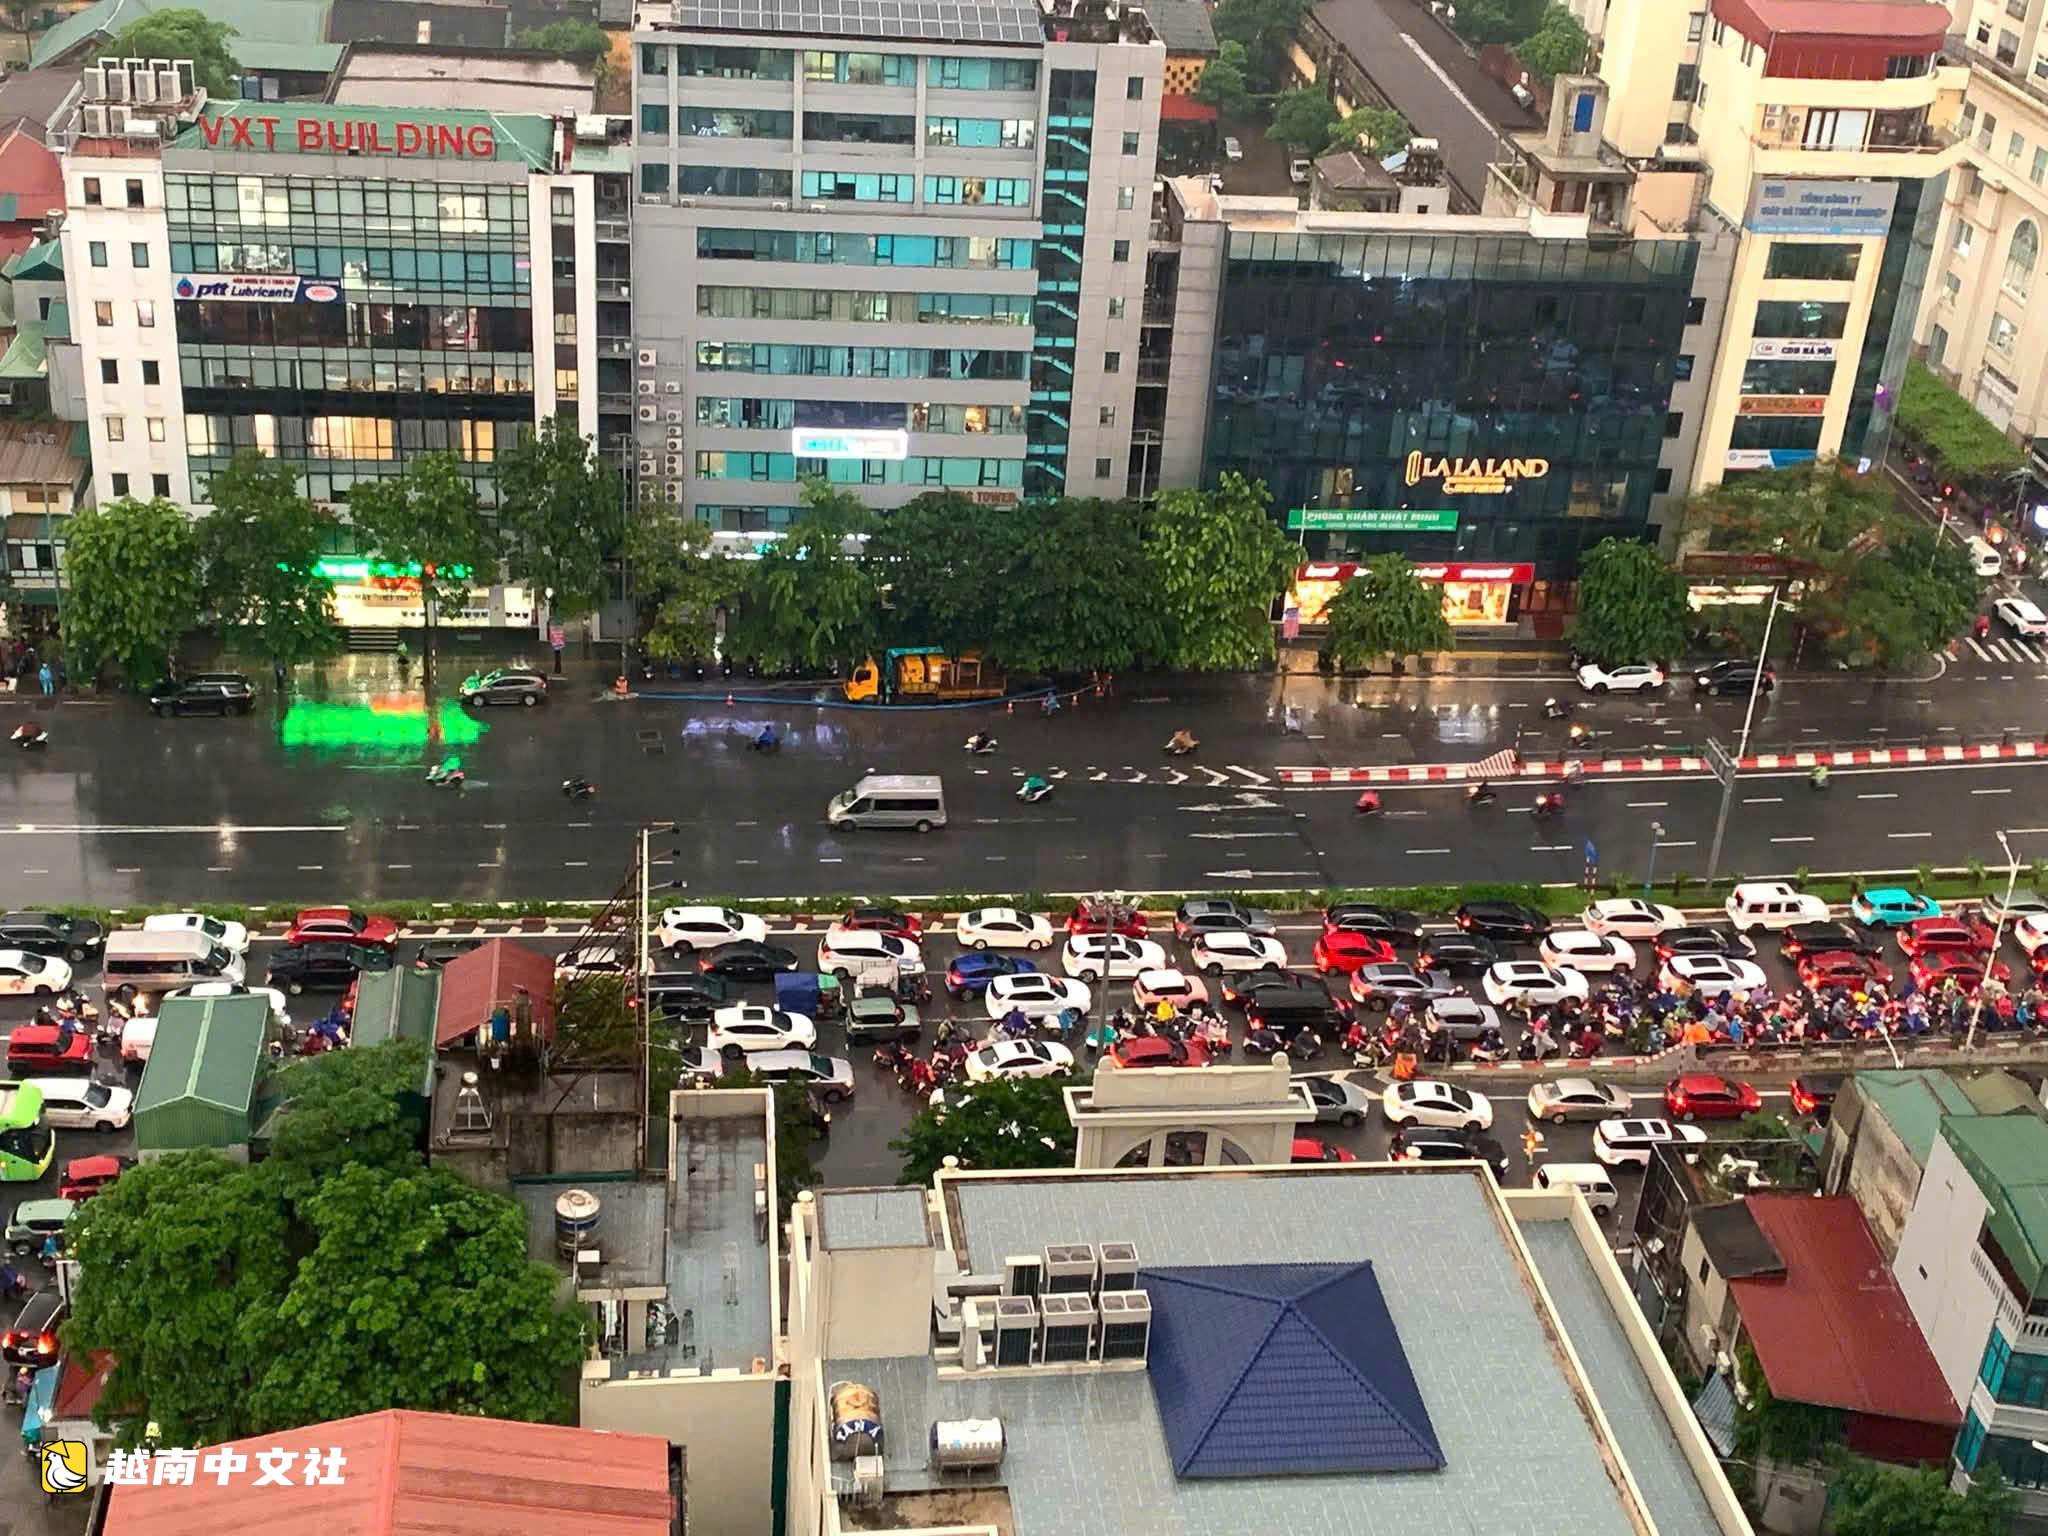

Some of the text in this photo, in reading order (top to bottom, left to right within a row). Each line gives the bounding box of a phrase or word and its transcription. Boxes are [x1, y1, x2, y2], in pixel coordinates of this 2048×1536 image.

[200, 115, 494, 157] VXT BUILDING
[197, 282, 230, 298] ptt
[231, 285, 294, 298] Lubricants
[1422, 457, 1550, 478] LA LA LAND
